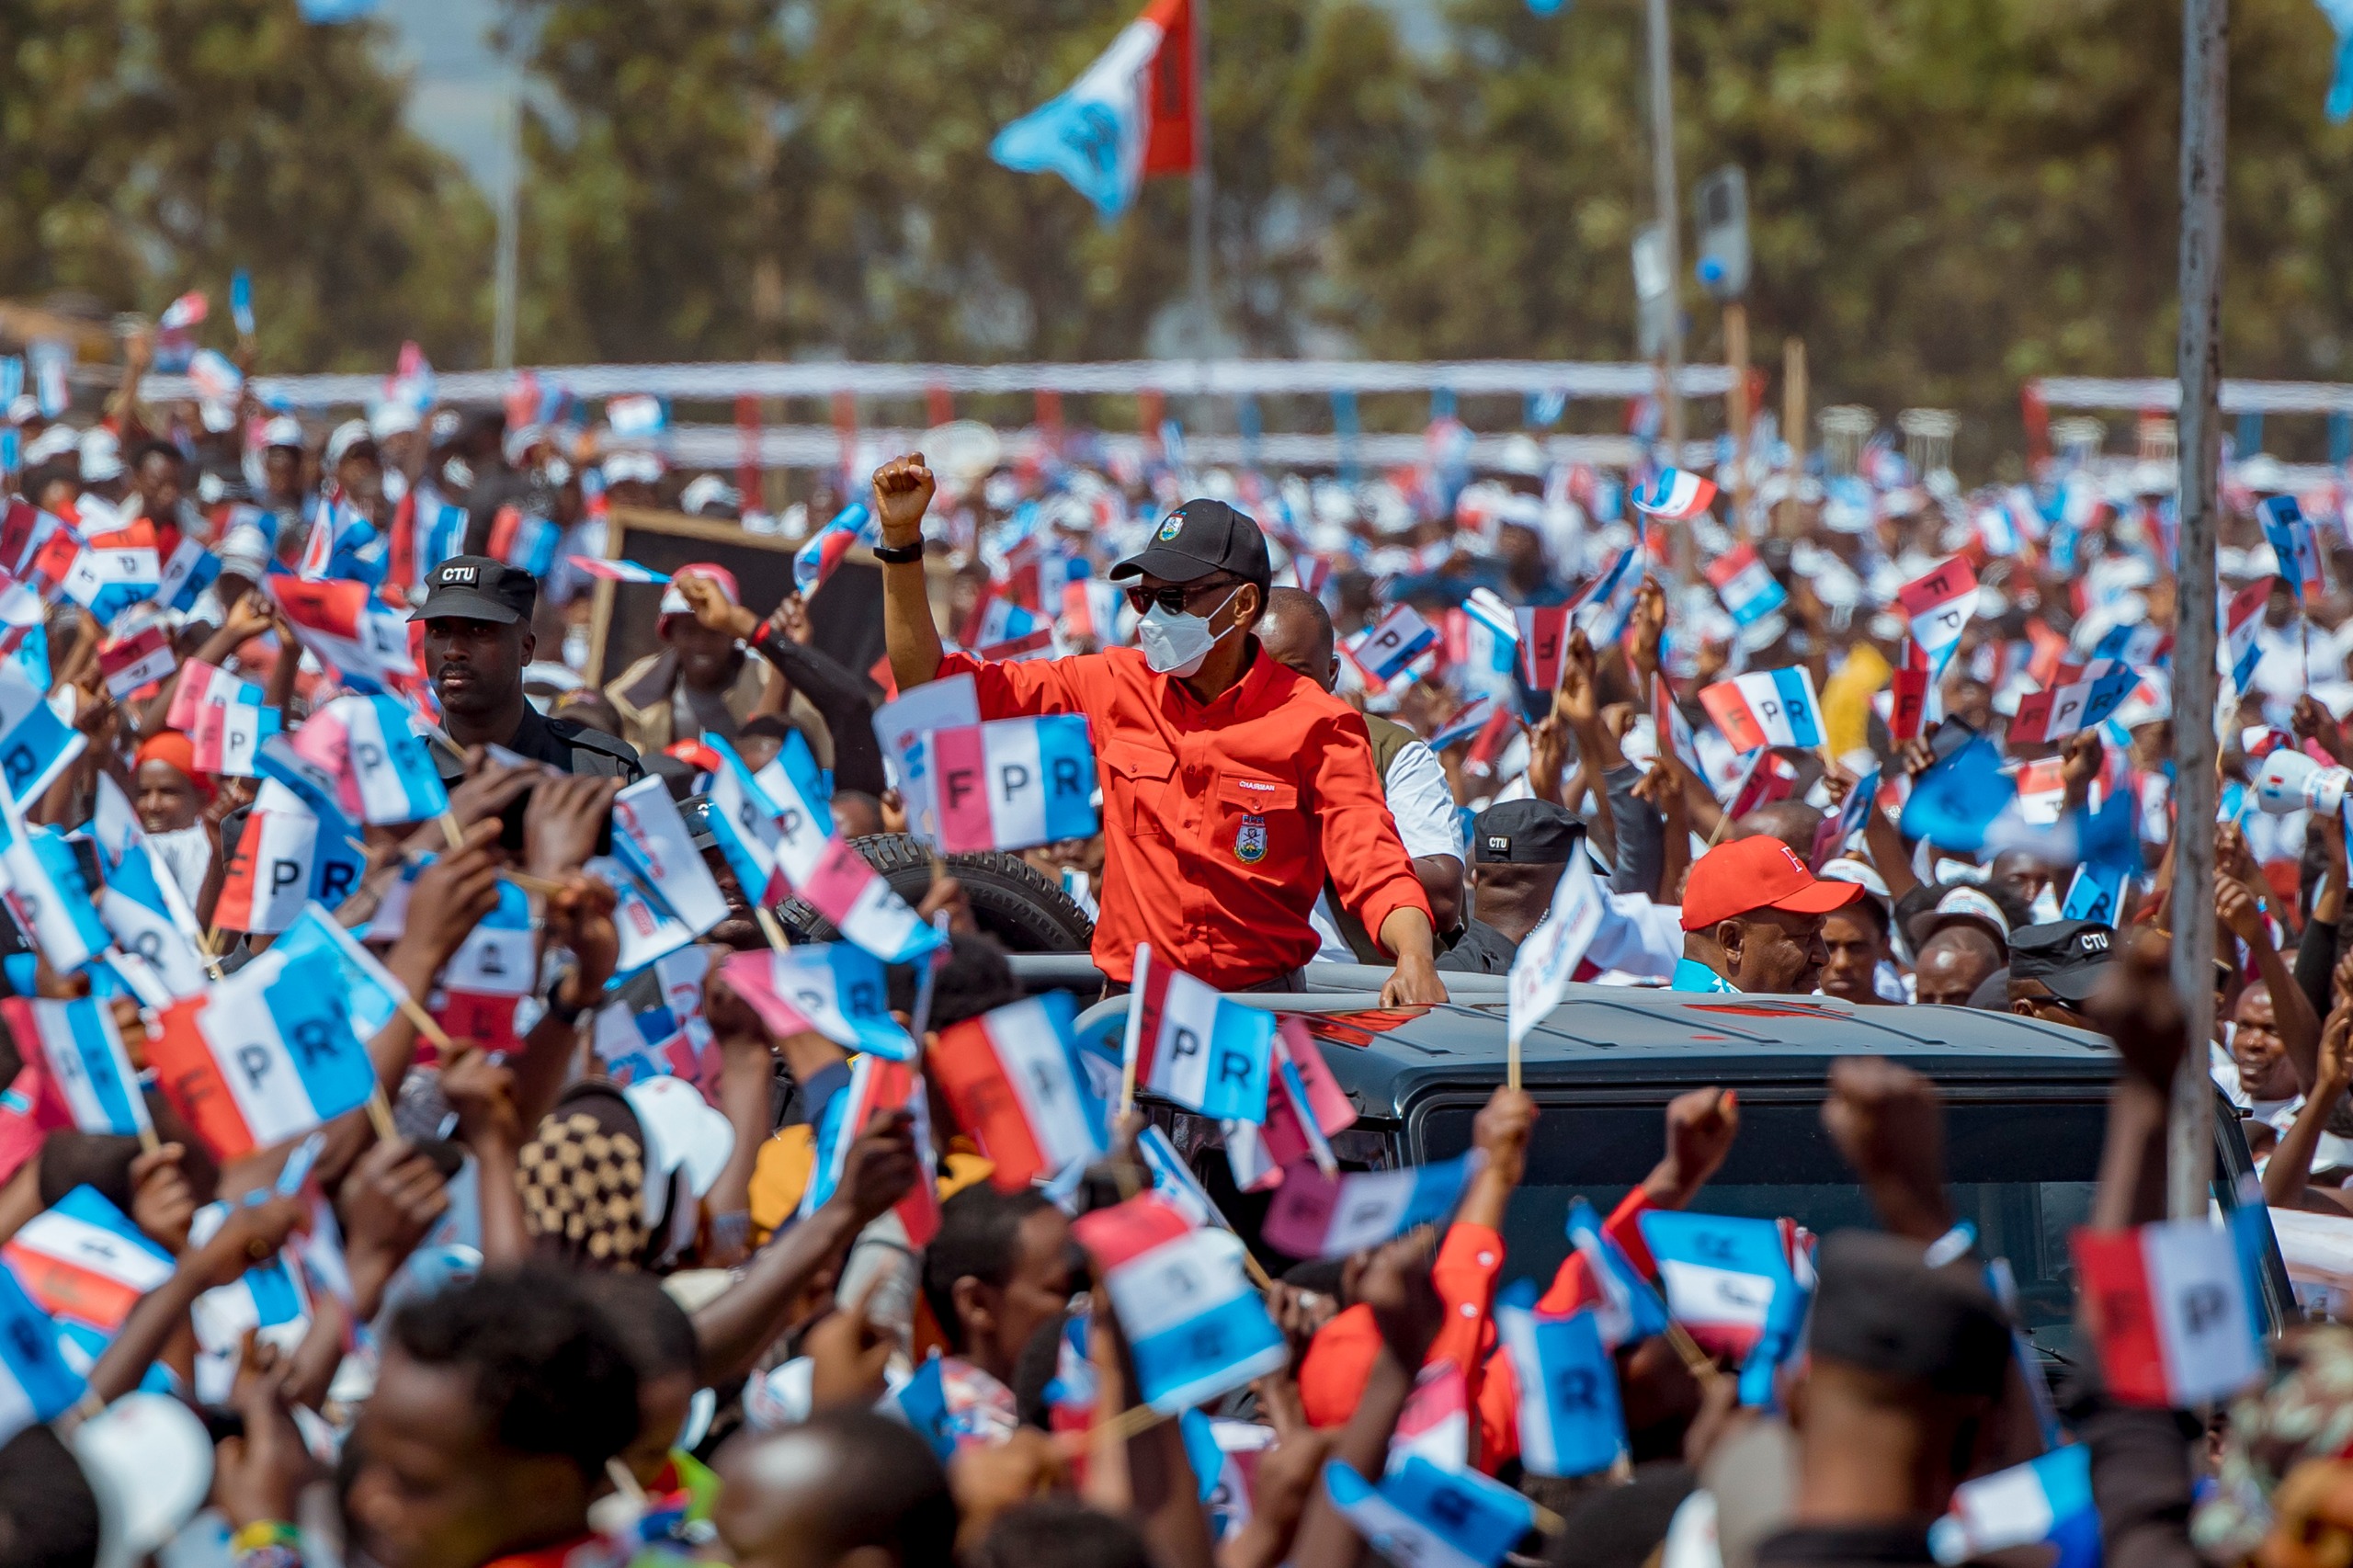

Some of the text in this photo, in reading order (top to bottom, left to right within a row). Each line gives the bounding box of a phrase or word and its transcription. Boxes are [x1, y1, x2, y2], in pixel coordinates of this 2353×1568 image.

[442, 567, 474, 581] CTU
[946, 757, 1081, 810] FPR
[1239, 780, 1276, 791] CHAIRMAN
[1489, 836, 1507, 849] CTU
[2081, 933, 2109, 950] CTU
